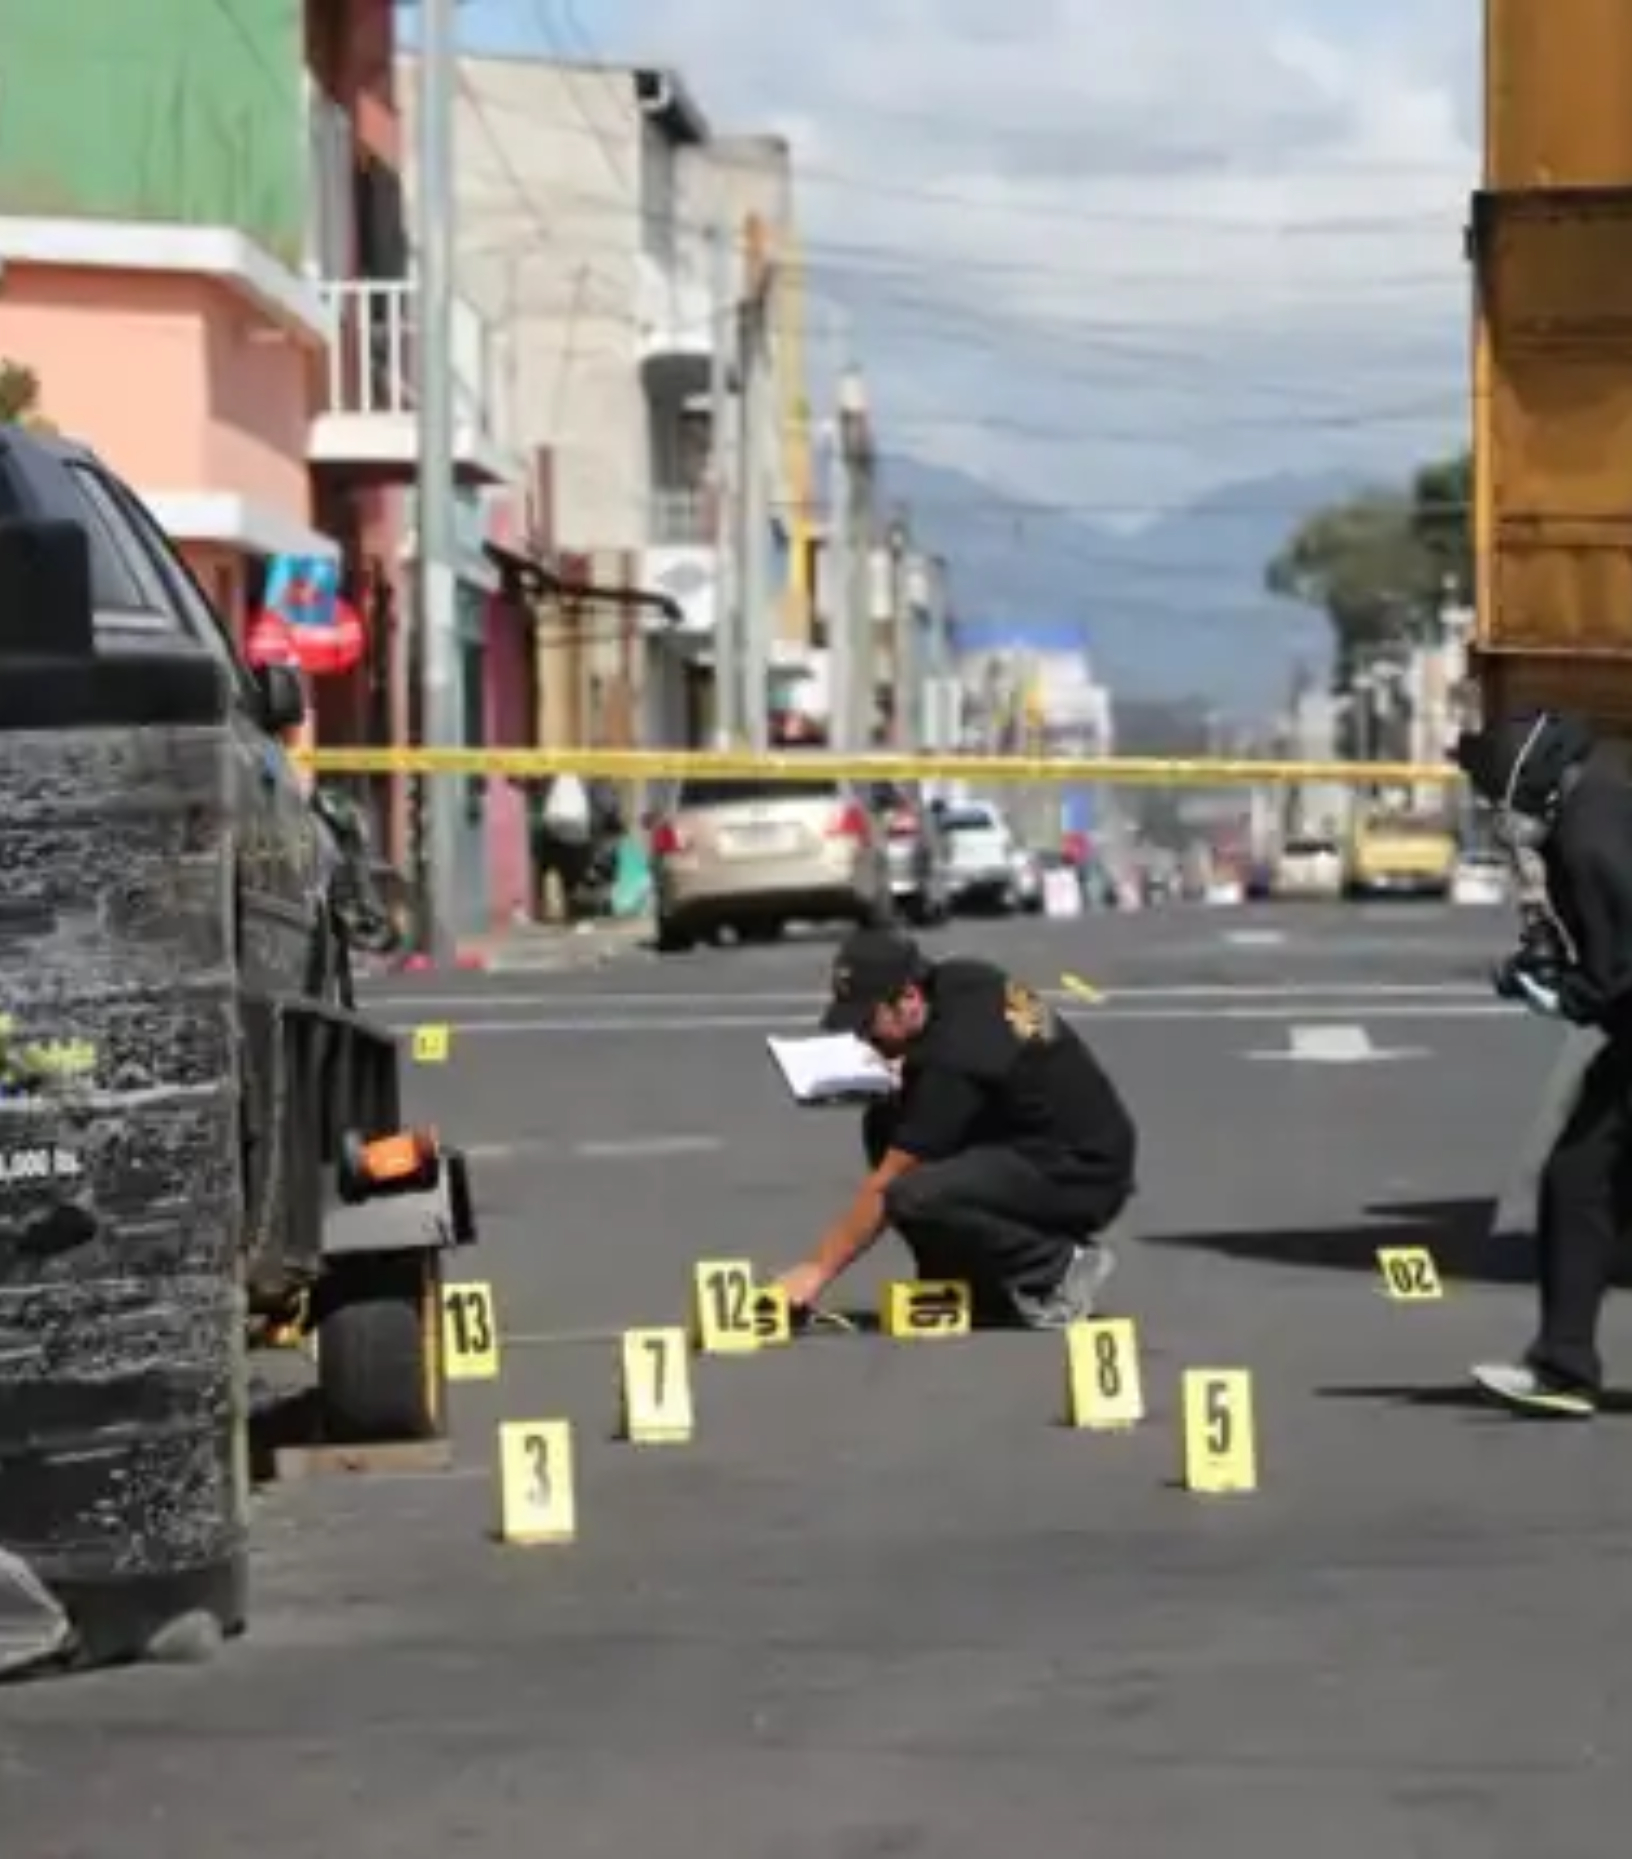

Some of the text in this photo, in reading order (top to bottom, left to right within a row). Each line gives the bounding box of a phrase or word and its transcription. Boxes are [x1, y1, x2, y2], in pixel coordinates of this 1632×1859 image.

[445, 1292, 490, 1353] 13
[706, 1270, 750, 1332] 12
[908, 1286, 960, 1328] 16
[644, 1338, 666, 1407] 7
[1095, 1331, 1119, 1397] 8
[1206, 1381, 1231, 1455] 5
[524, 1434, 551, 1507] 3
